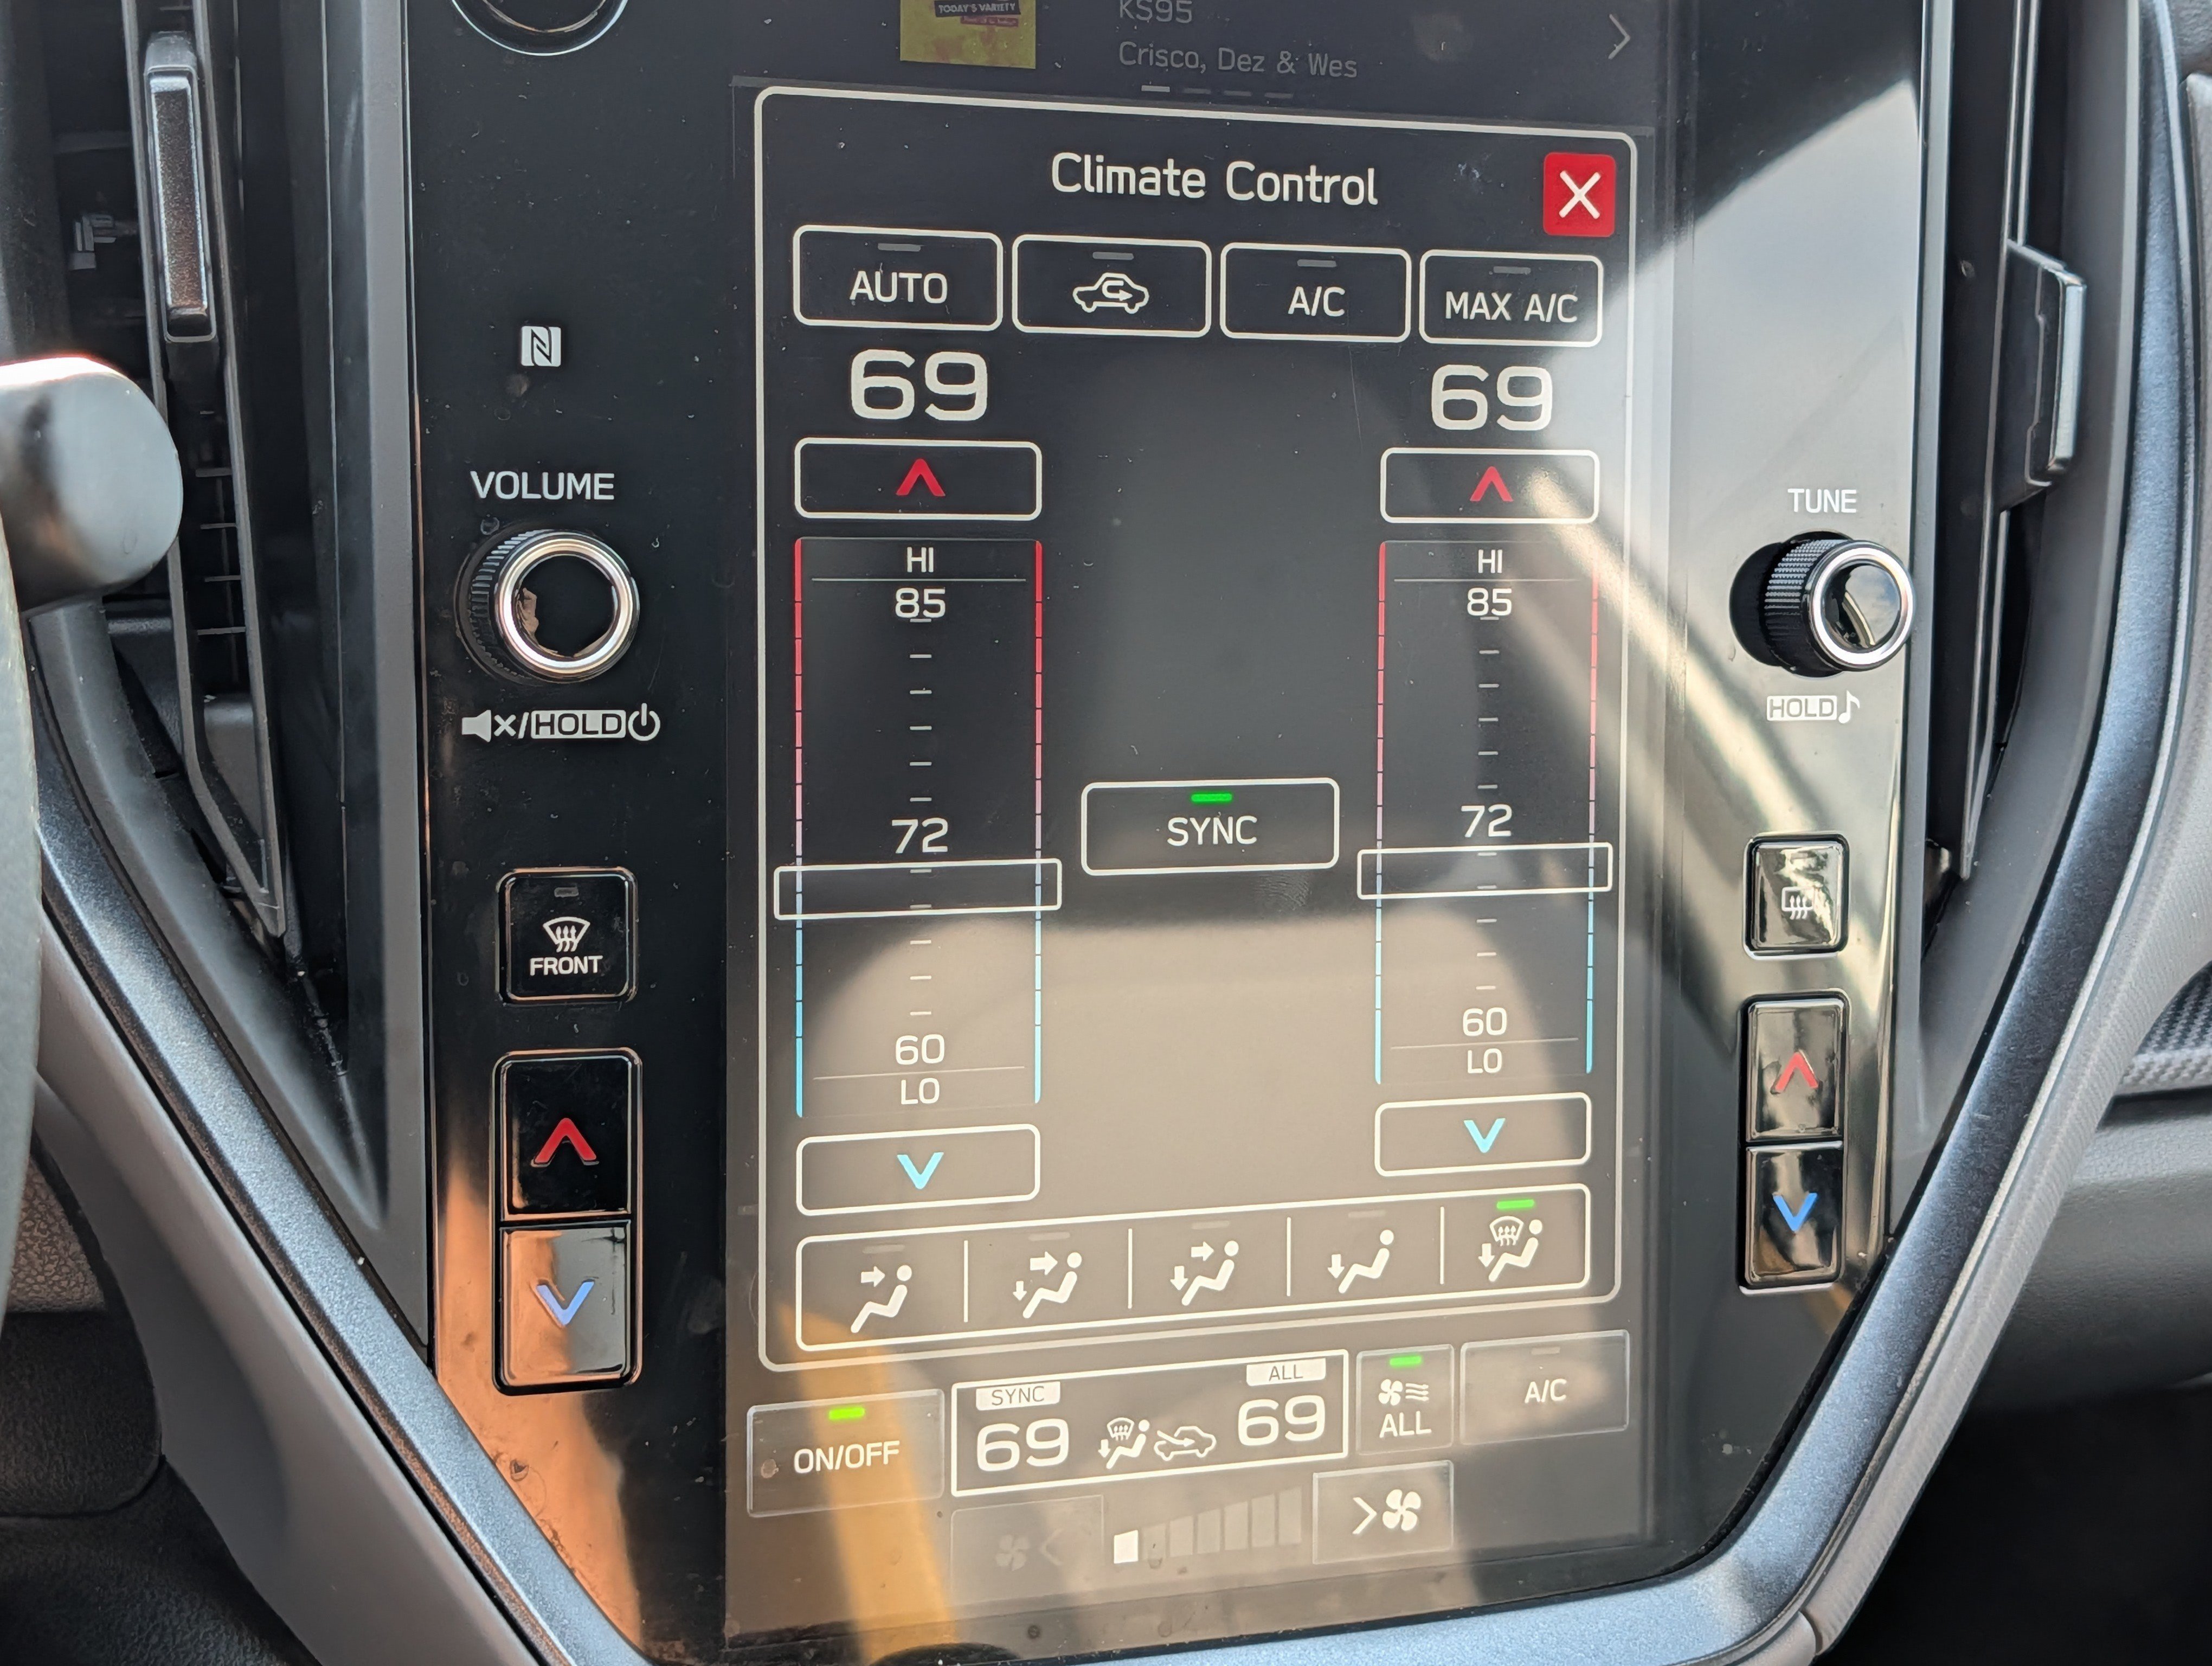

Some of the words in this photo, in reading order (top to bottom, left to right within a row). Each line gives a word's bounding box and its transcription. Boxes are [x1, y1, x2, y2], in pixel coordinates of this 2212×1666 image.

[979, 3, 1015, 11] VARIETY
[1120, 0, 1192, 23] KS95
[1120, 41, 1206, 74] Crisco,
[1218, 47, 1265, 72] Dez
[1277, 50, 1296, 74] &
[1308, 53, 1357, 78] Wes
[1052, 152, 1206, 198] Climate
[1226, 161, 1378, 206] Control
[850, 271, 948, 304] AUTO
[1288, 286, 1345, 317] A/C
[1445, 291, 1512, 321] MAX
[1524, 293, 1578, 323] A/C
[851, 349, 988, 421] 69
[1431, 364, 1553, 431] 69
[470, 471, 614, 499] VOLUME
[1787, 488, 1857, 513] TUNE
[906, 547, 934, 572] HI
[1478, 549, 1502, 573] HI
[895, 587, 946, 618] 85
[1467, 587, 1512, 616] 85
[1770, 699, 1834, 718] HOLD
[892, 817, 948, 853] 72
[1167, 816, 1257, 846] SYNC
[1461, 804, 1512, 838] 72
[530, 955, 603, 976] FRONT
[1462, 1007, 1508, 1036] 60
[896, 1034, 945, 1065] 60
[1467, 1048, 1503, 1074] LO
[901, 1078, 940, 1105] LO
[1269, 1366, 1303, 1381] ALL
[992, 1386, 1044, 1406] SYNC
[1525, 1379, 1567, 1404] A/C
[1238, 1395, 1326, 1446] 69
[1380, 1411, 1432, 1438] ALL
[793, 1440, 901, 1473] ON/OFF
[976, 1418, 1069, 1471] 69
